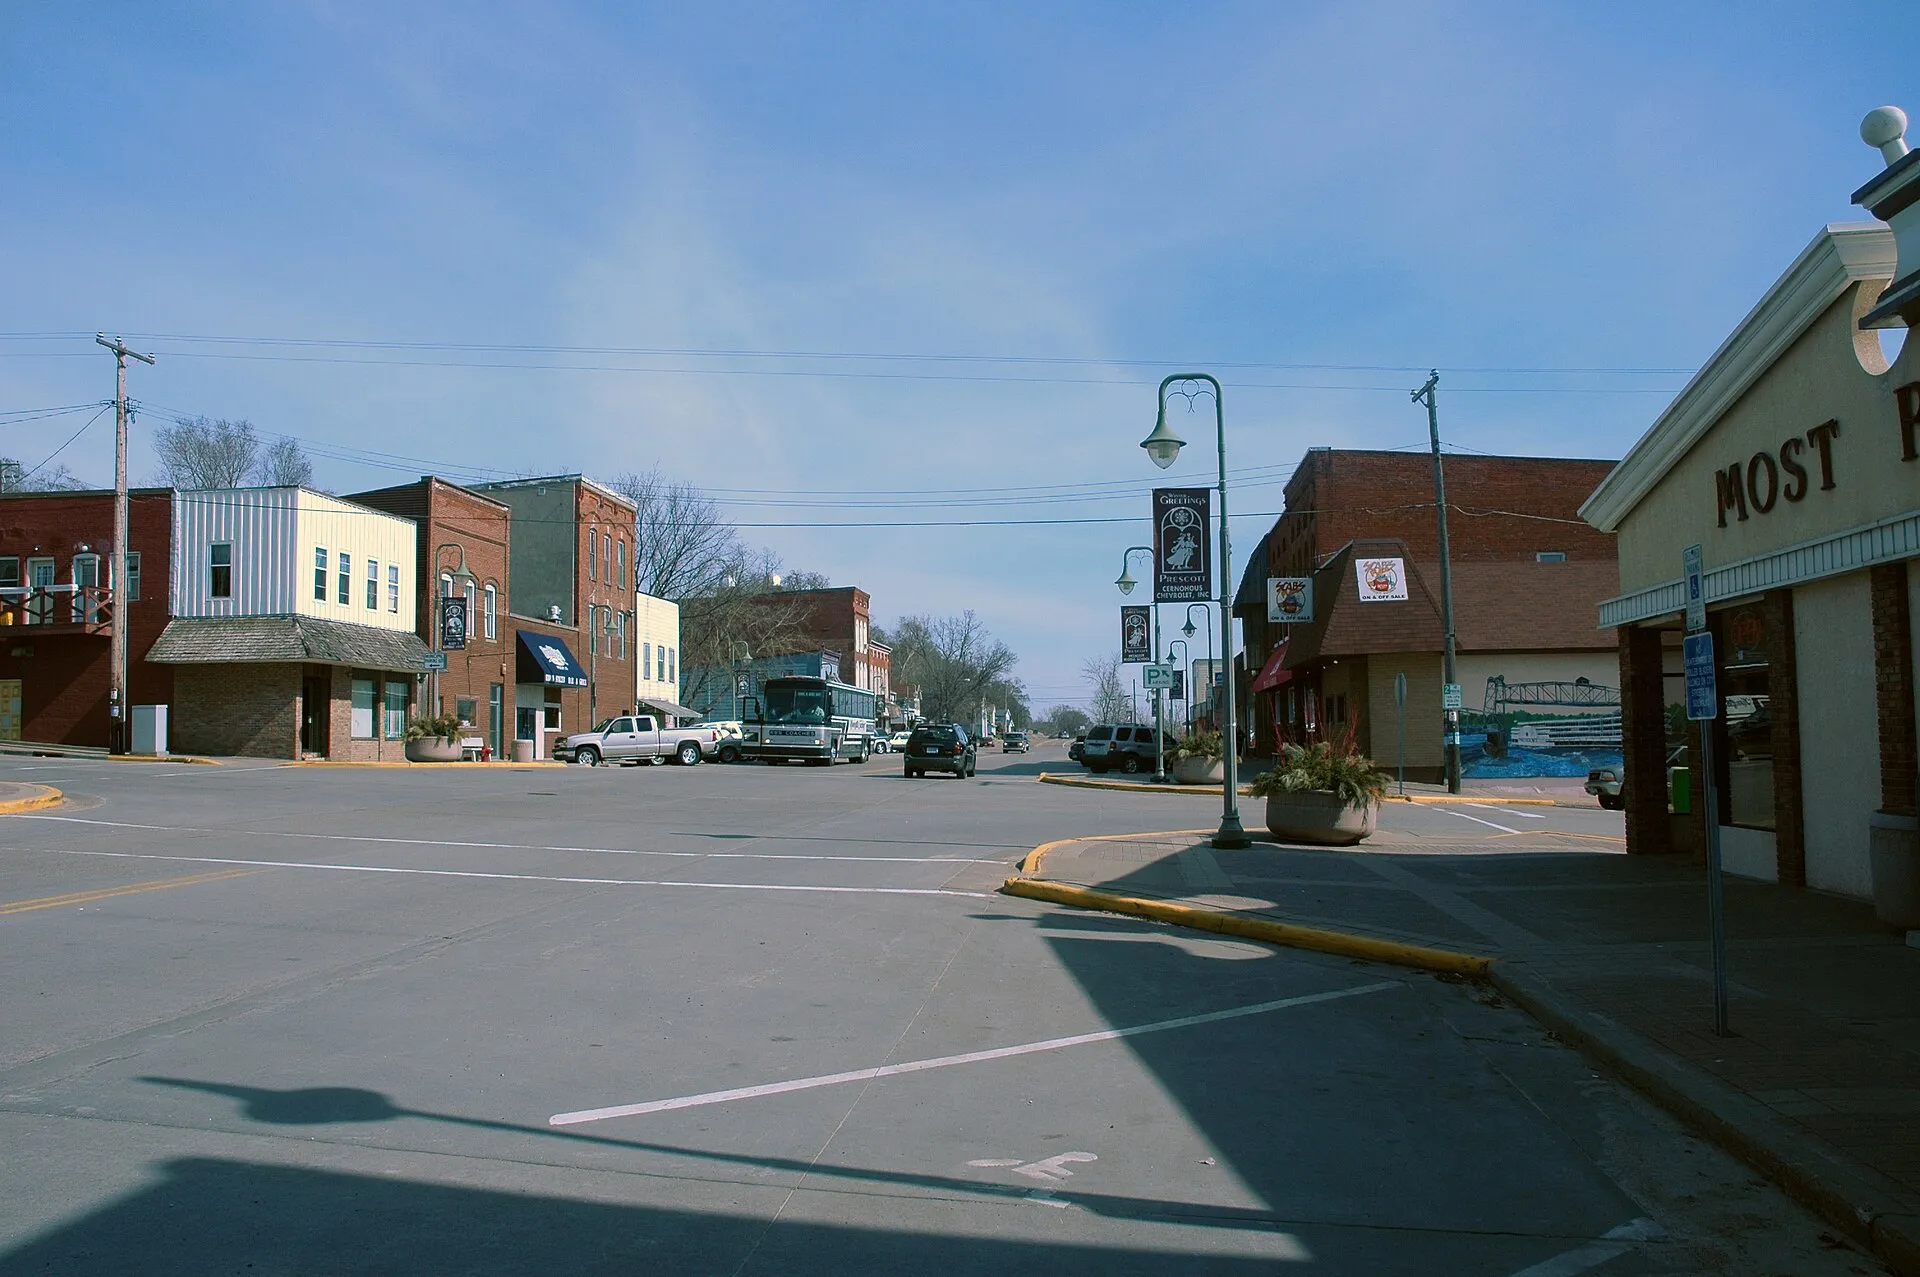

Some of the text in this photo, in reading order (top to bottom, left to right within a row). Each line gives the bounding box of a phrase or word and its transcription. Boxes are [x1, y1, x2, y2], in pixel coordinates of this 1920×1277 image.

[1715, 418, 1839, 528] MOST
[1159, 495, 1206, 506] GREETINGS
[1159, 574, 1206, 583] PRESCOTT
